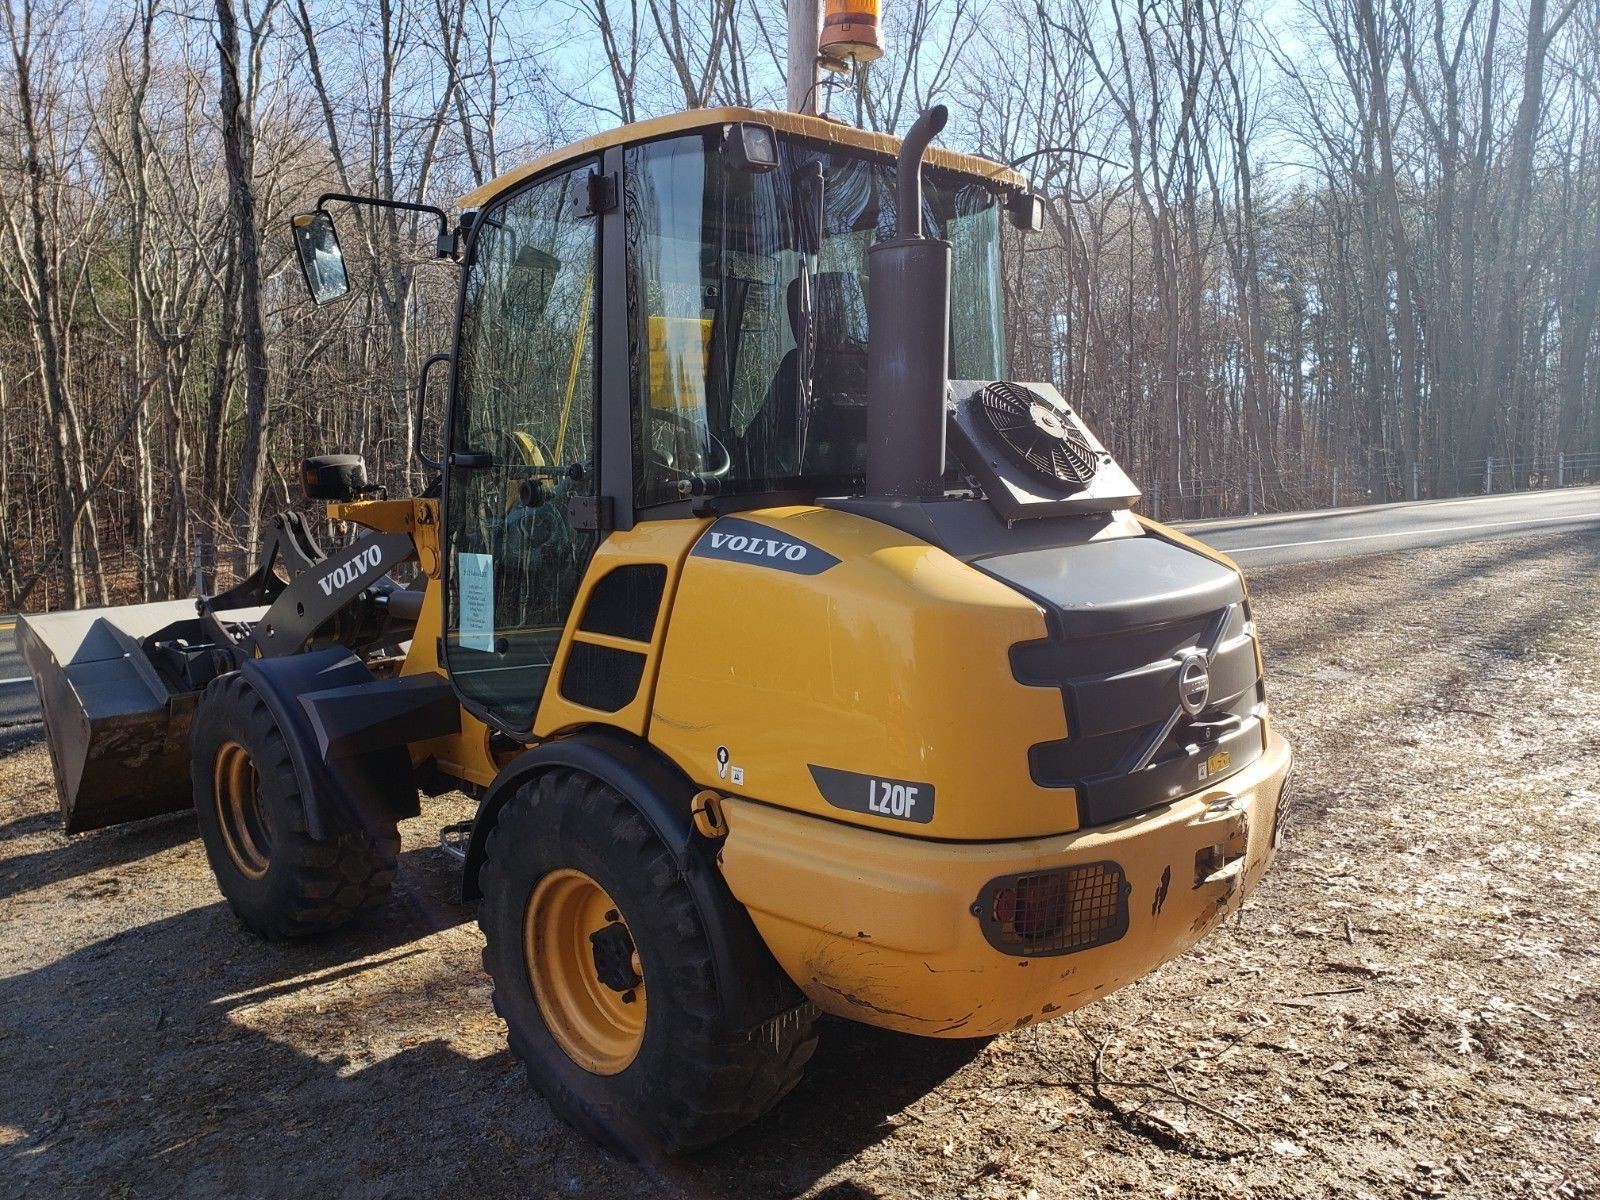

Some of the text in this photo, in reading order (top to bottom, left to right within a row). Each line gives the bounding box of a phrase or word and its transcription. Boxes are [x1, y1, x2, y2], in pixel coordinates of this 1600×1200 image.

[710, 532, 807, 561] VOLVO
[317, 544, 382, 596] VOLVO
[869, 779, 919, 818] L20F
